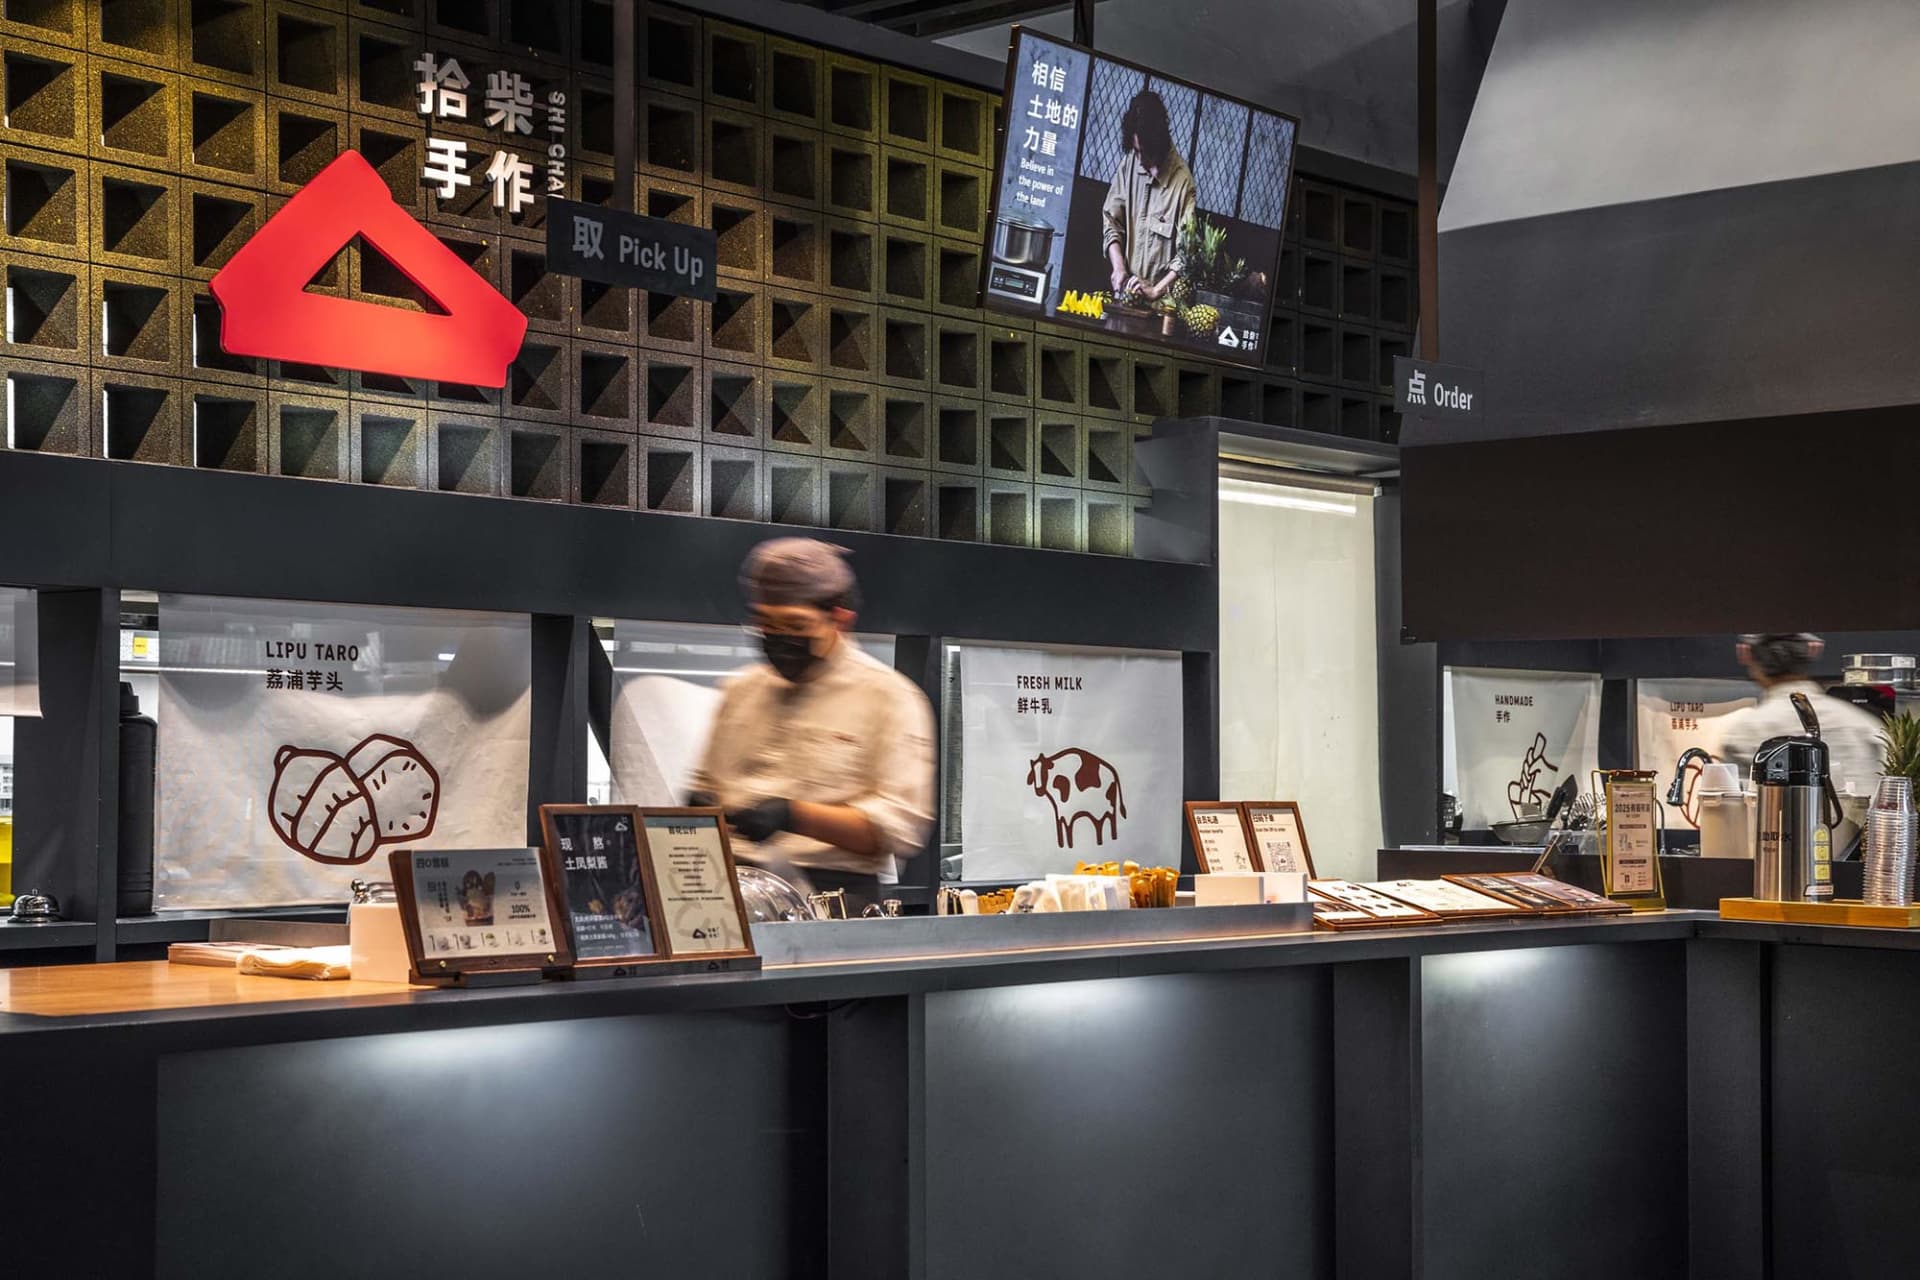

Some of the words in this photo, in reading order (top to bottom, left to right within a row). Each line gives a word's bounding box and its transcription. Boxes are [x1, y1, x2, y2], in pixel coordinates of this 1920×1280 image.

[1031, 60, 1067, 93] 相信
[413, 52, 535, 135] 拾柴
[547, 91, 566, 133] SHI
[1027, 94, 1079, 129] 土地的
[1023, 126, 1058, 157] 力量
[421, 136, 535, 213] 手作
[1020, 157, 1046, 175] Believe
[1046, 165, 1055, 177] in
[1018, 175, 1031, 188] the
[1031, 179, 1055, 193] power
[1055, 184, 1065, 196] of
[1015, 191, 1029, 203] the
[1029, 194, 1046, 208] land
[572, 216, 605, 261] 取
[618, 235, 667, 272] Pick
[674, 246, 704, 286] Up
[1407, 369, 1427, 406] 点
[1434, 382, 1473, 411] Order
[265, 641, 307, 660] LIPU
[314, 643, 360, 662] TARO
[265, 668, 344, 692] 荔浦芋头
[1016, 675, 1051, 691] FRESH
[1054, 676, 1083, 691] MILK
[1017, 697, 1053, 715] 鲜牛乳
[1494, 694, 1534, 707] HANDMADE
